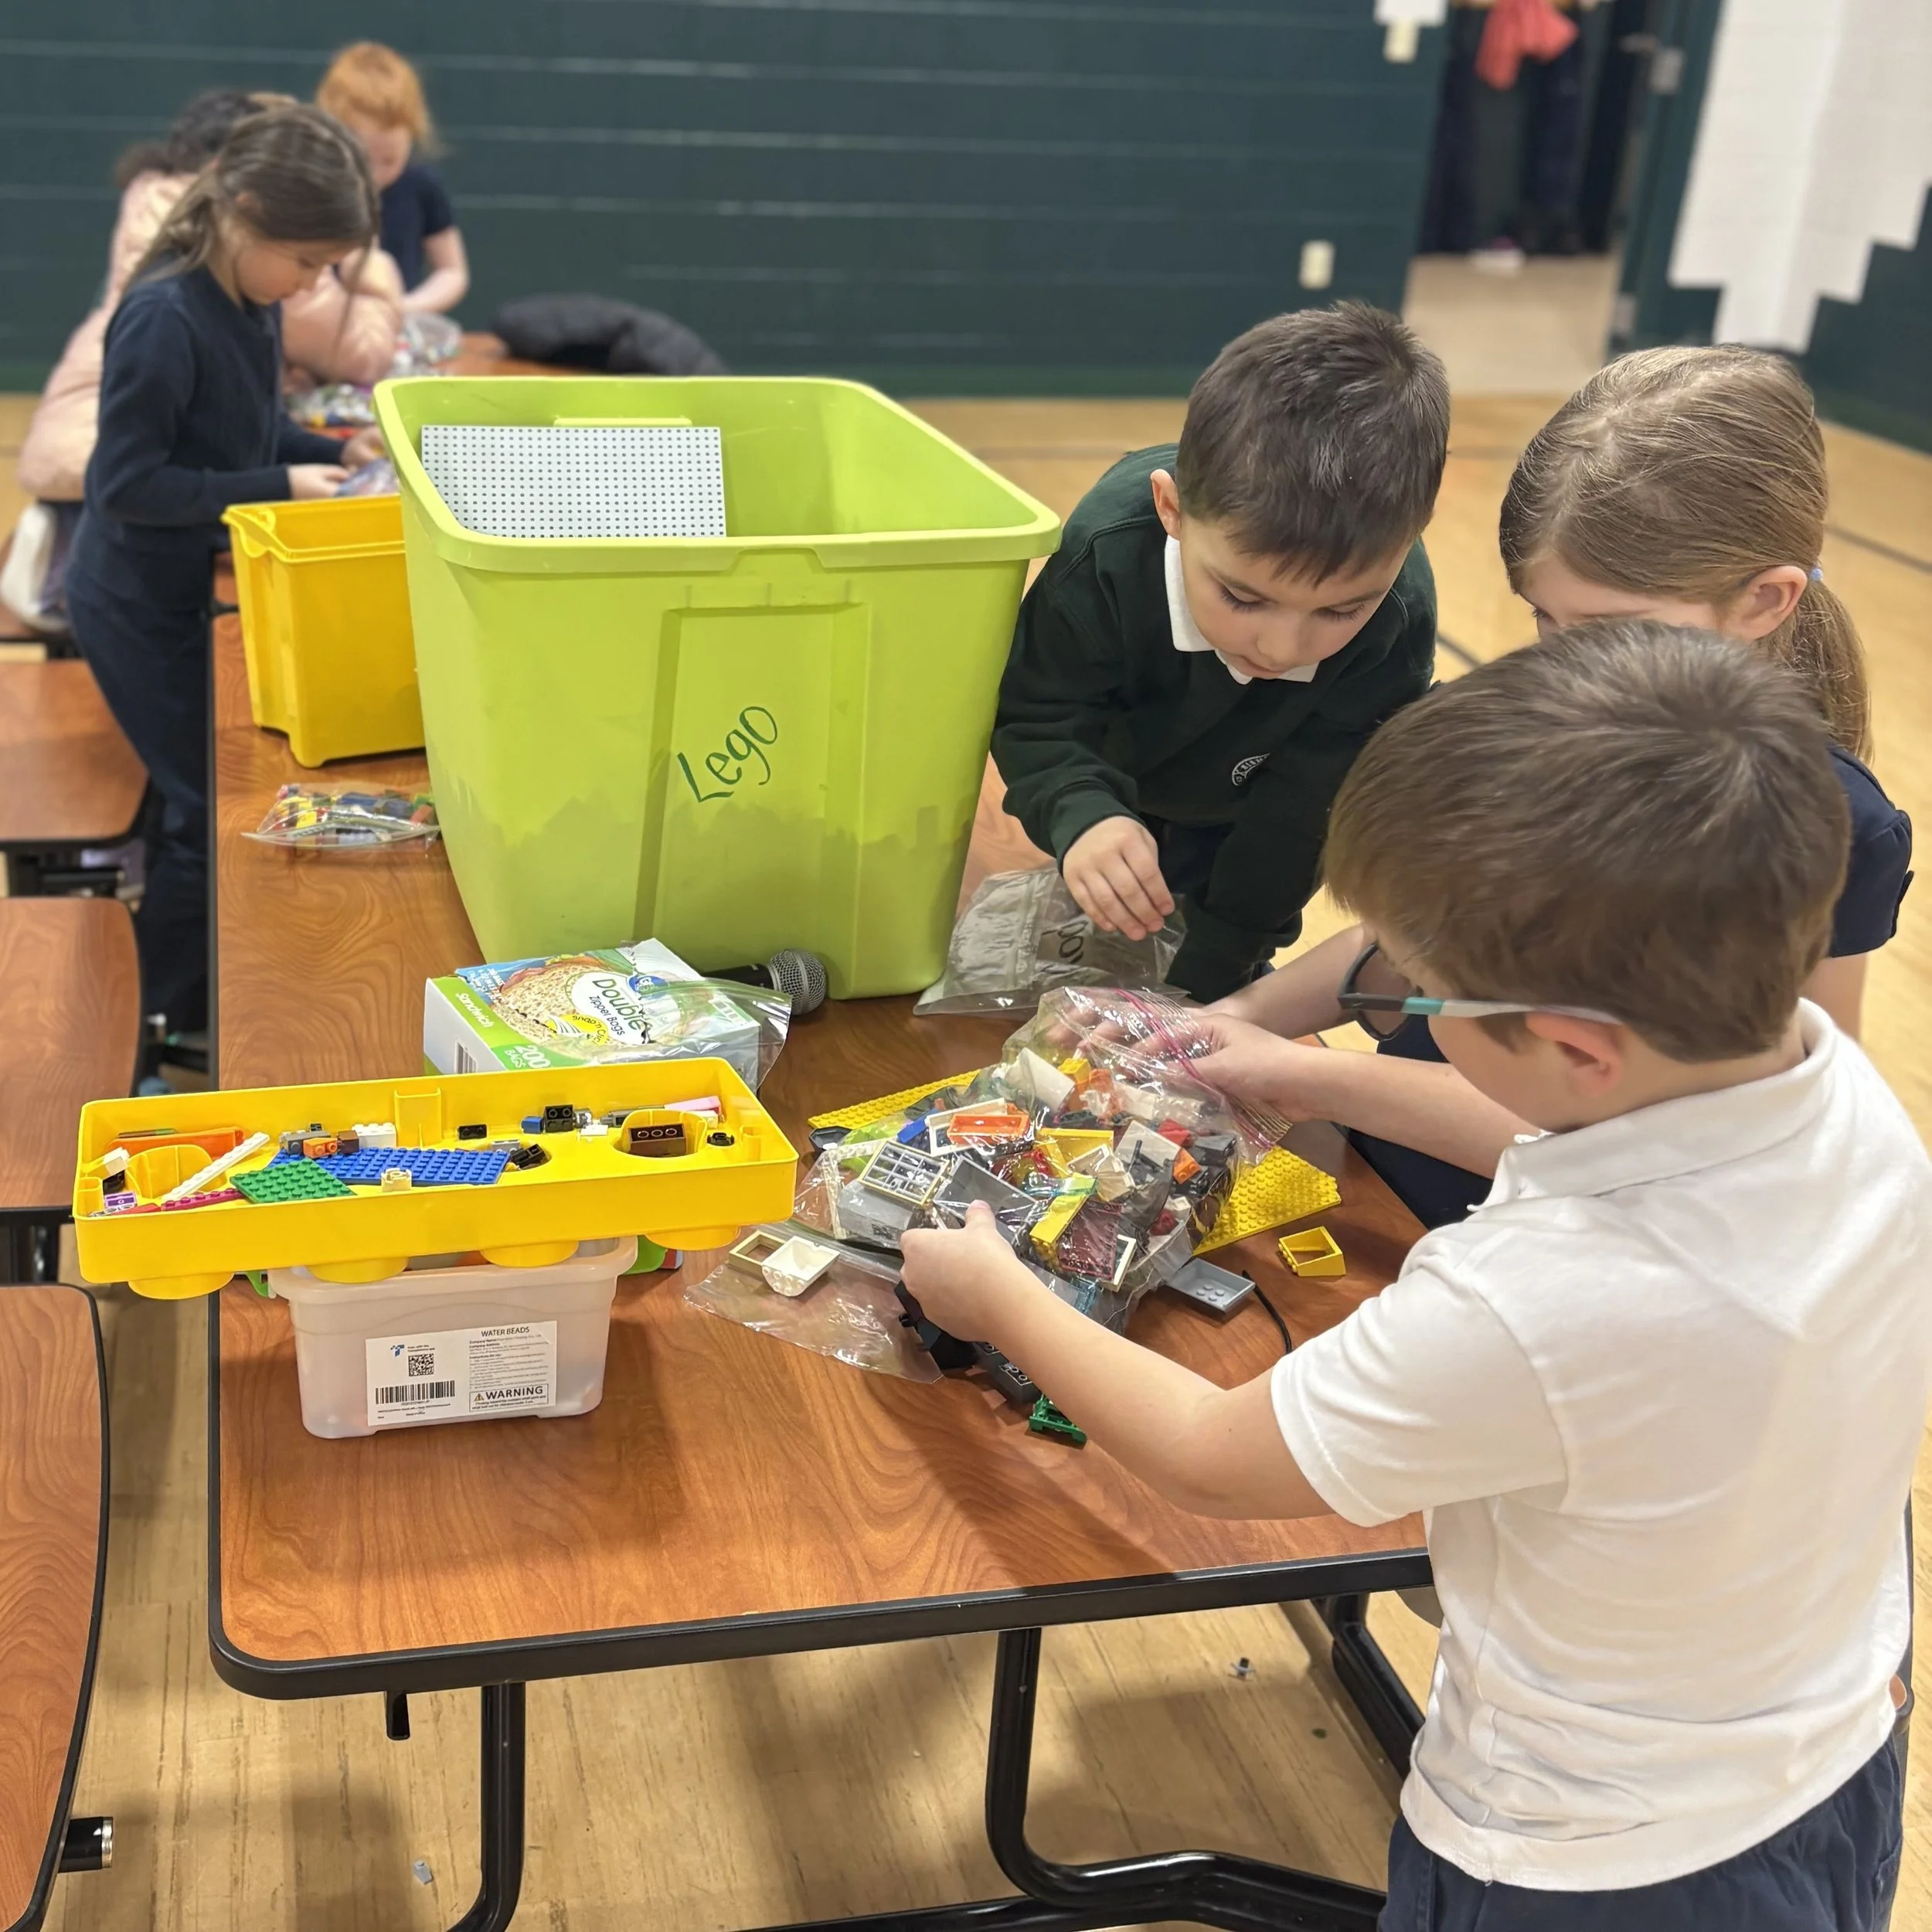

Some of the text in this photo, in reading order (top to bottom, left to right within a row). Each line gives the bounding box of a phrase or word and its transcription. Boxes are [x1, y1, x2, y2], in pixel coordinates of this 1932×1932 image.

[677, 706, 777, 802] Lego
[455, 993, 495, 1028] Sandwich
[592, 978, 642, 1030] Double
[607, 1016, 625, 1036] Bags
[504, 1049, 526, 1068] BAGS
[514, 1045, 551, 1068] 200
[481, 1326, 530, 1337] WATER BEADS
[485, 1386, 543, 1400] WARNING
